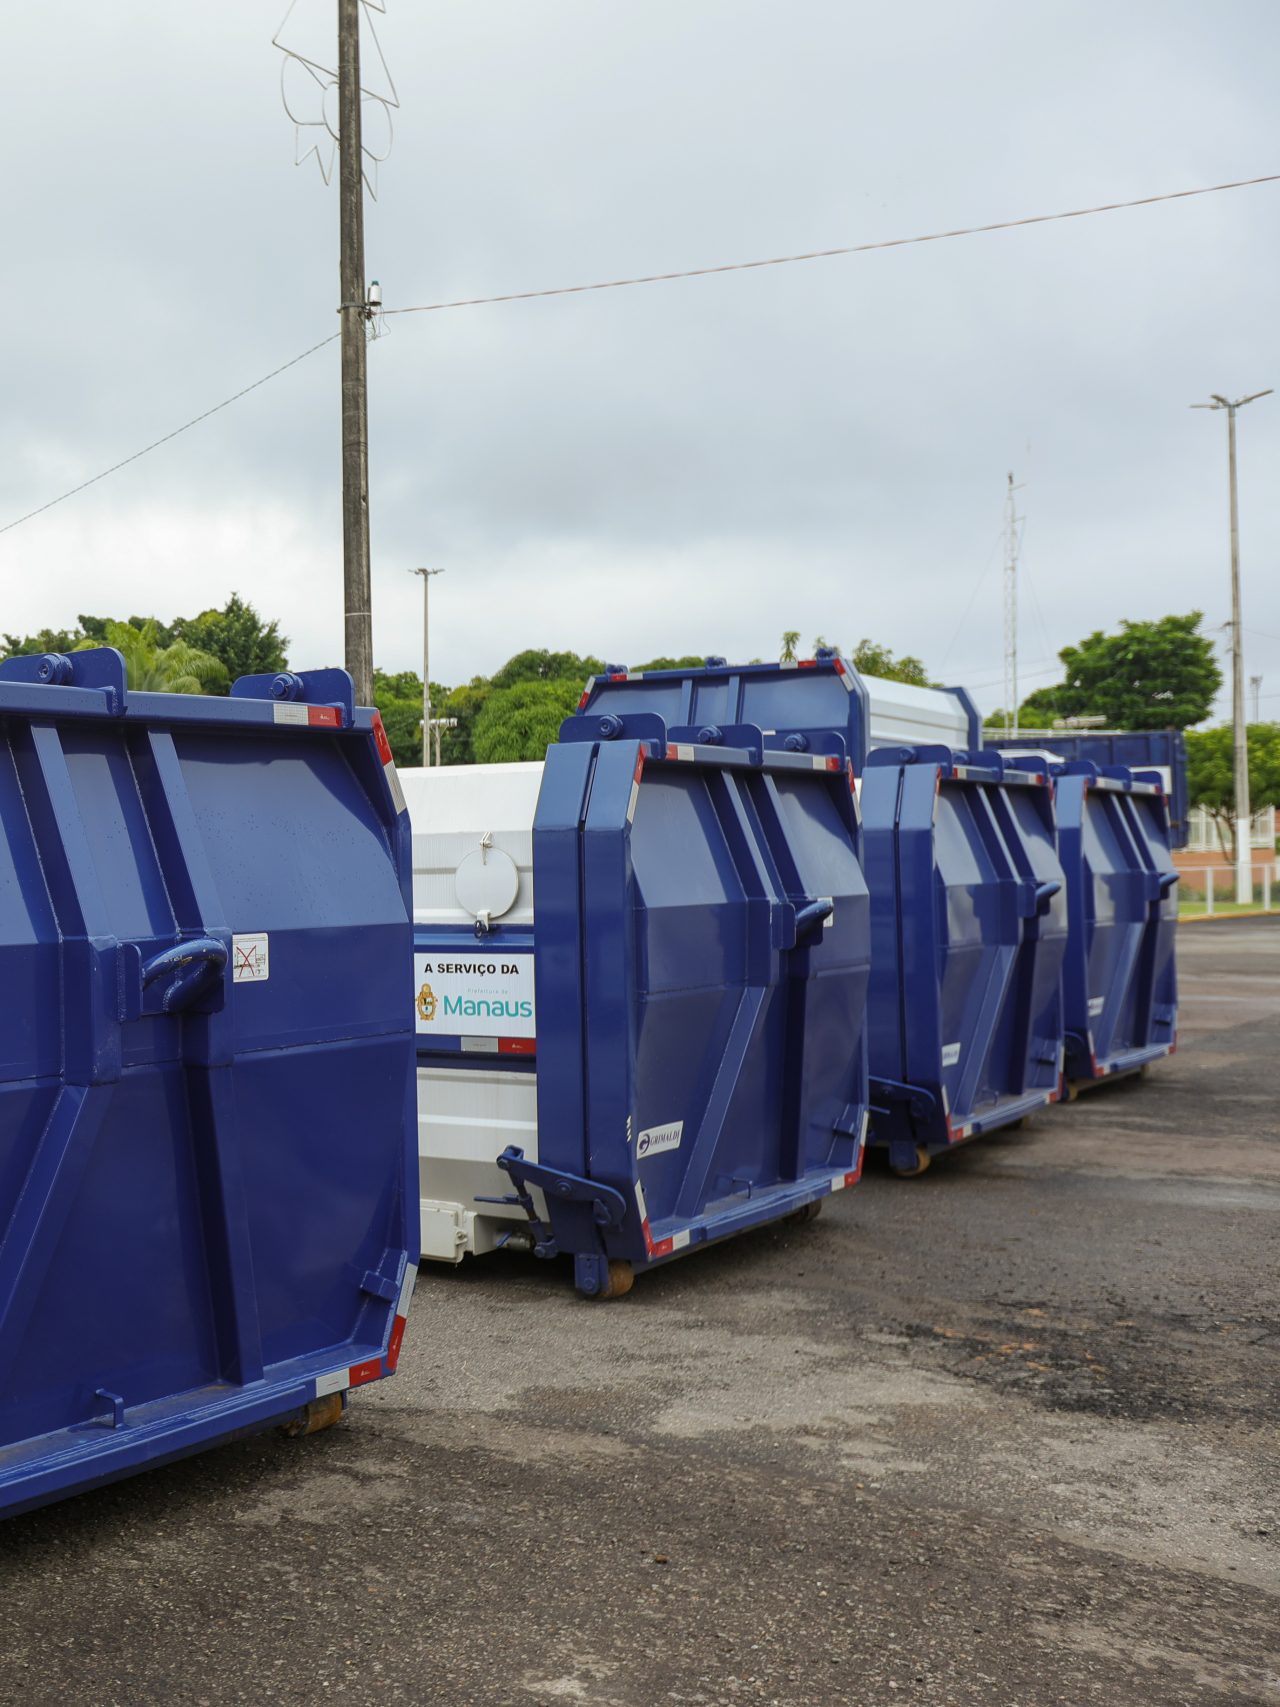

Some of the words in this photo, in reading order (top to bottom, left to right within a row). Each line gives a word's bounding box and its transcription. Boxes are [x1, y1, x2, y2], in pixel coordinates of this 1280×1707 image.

[424, 963, 433, 973] A
[437, 963, 496, 977] SERVIÇO
[501, 964, 520, 975] DA
[443, 995, 533, 1018] Manaus
